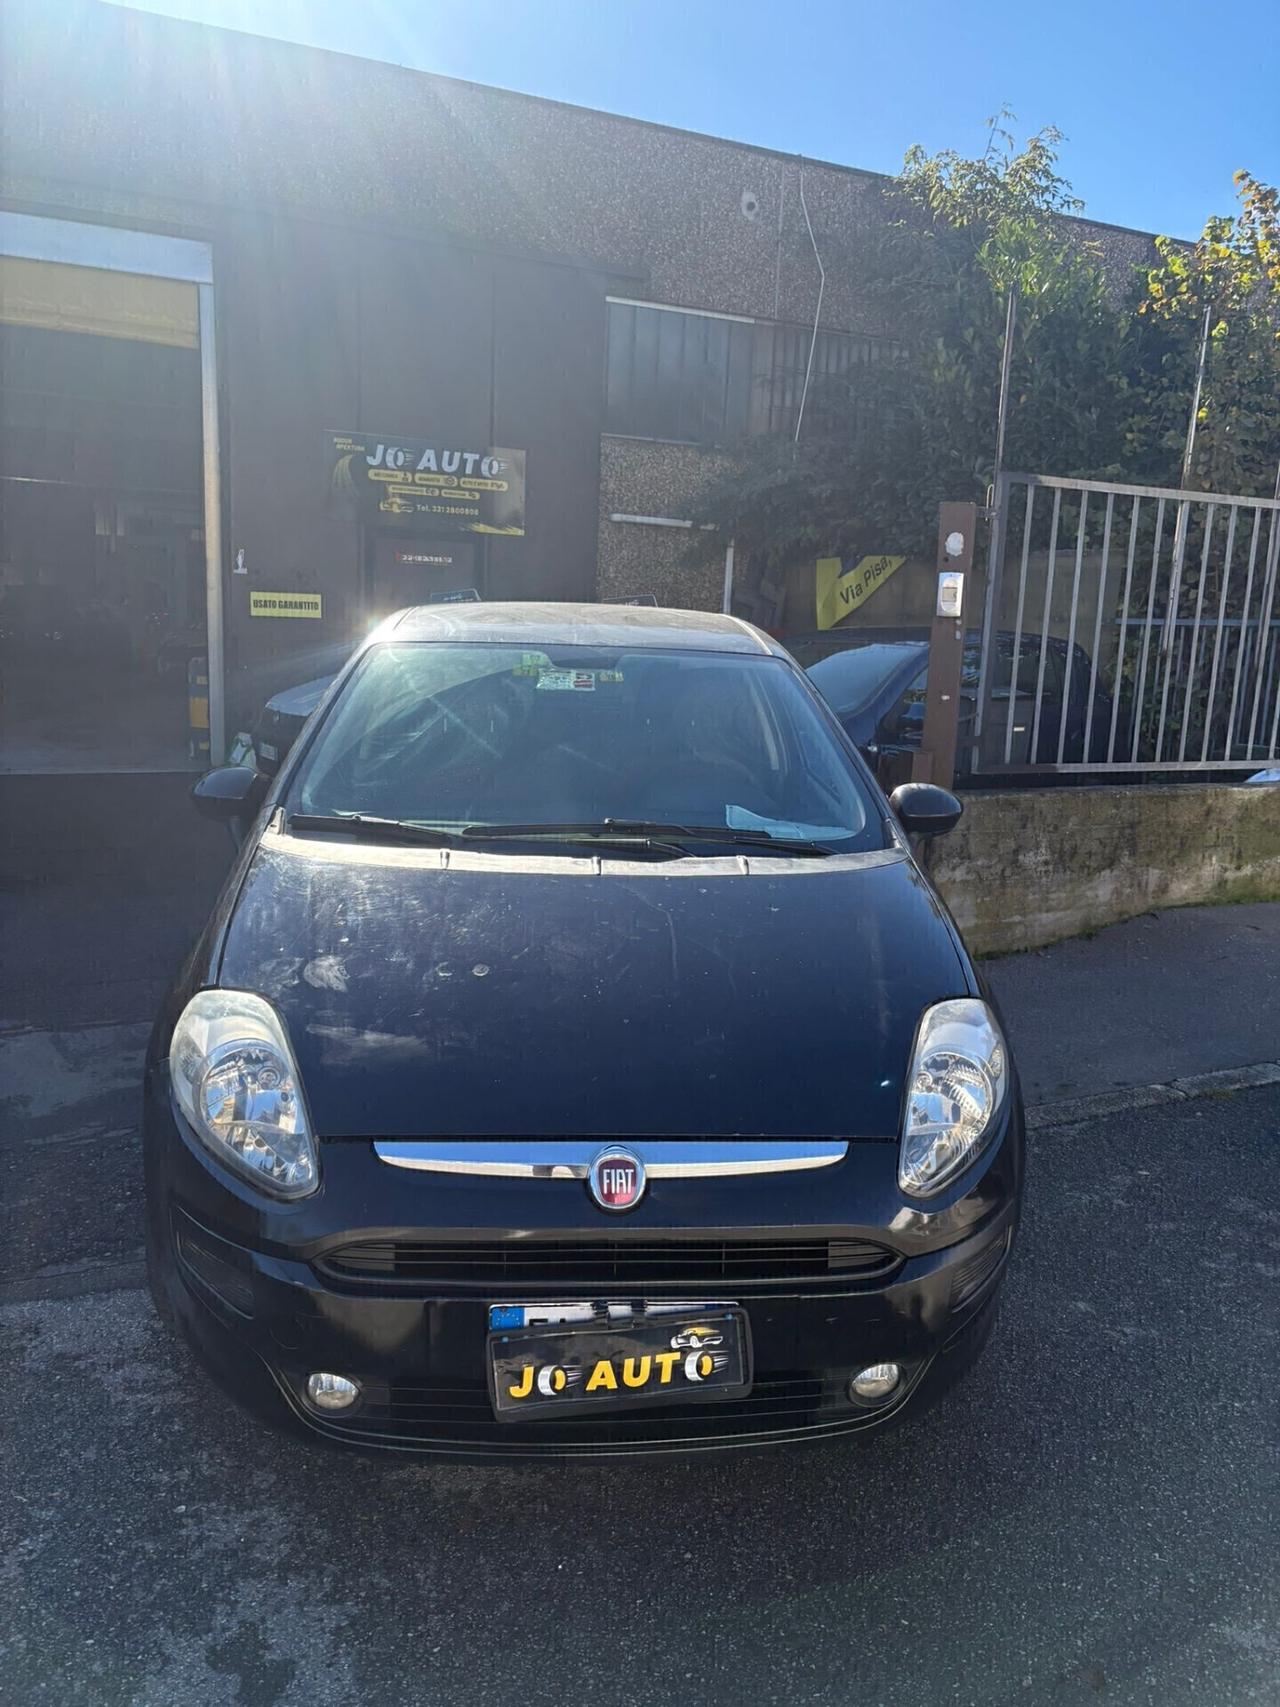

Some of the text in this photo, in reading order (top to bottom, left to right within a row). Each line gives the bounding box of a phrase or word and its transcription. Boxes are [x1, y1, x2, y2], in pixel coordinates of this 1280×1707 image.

[366, 444, 499, 477] JO AUTO
[253, 599, 319, 611] USATO GARANTITO
[840, 583, 863, 604] Via
[603, 1168, 634, 1194] FIAT
[509, 1350, 714, 1398] JO AUTO
